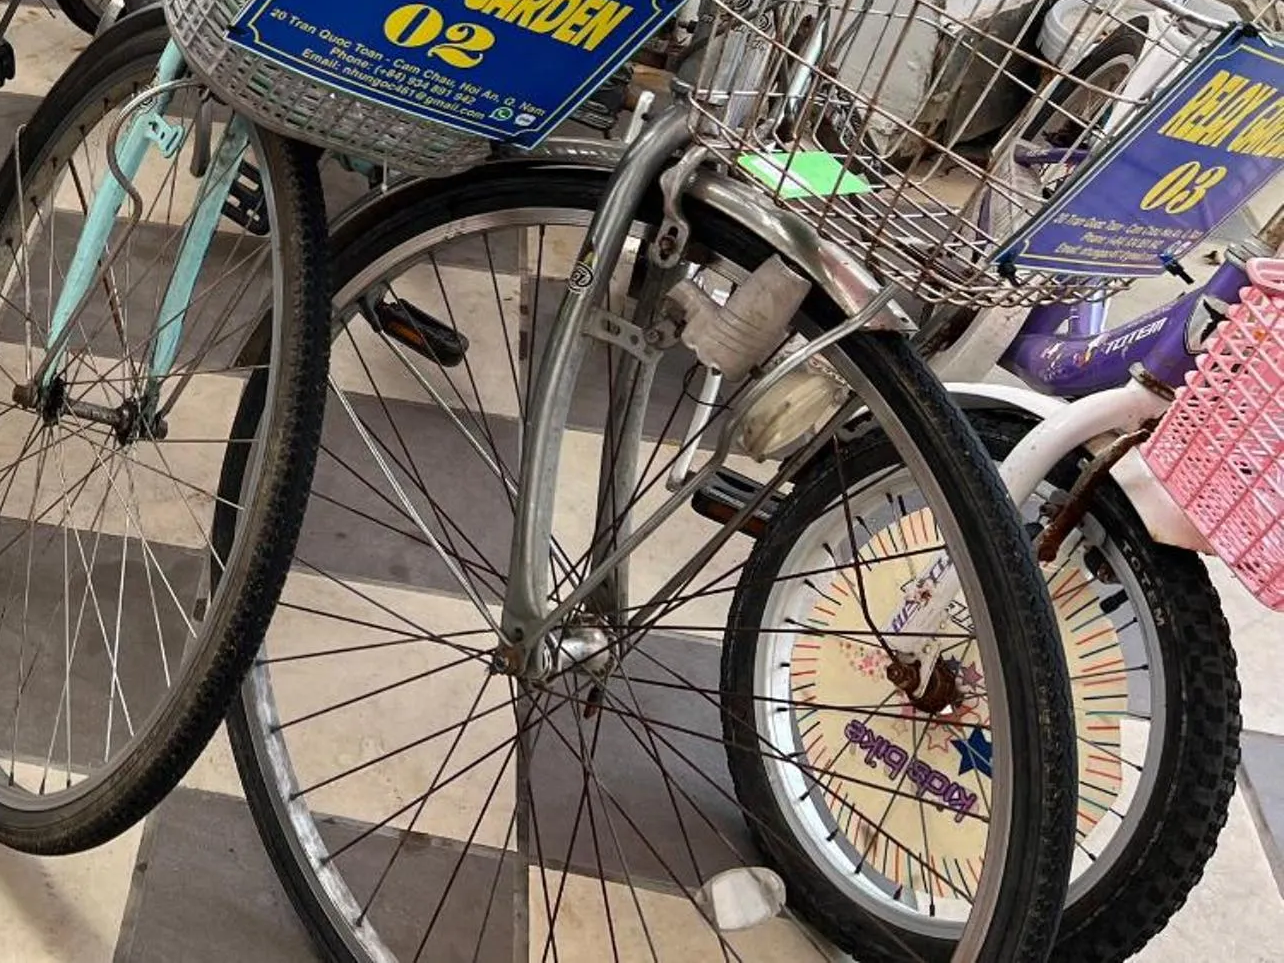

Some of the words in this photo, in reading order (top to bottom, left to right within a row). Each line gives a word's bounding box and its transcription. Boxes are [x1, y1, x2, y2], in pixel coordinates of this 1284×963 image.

[270, 7, 287, 21] 20
[288, 15, 317, 35] Tran
[318, 29, 352, 48] Quoc
[355, 42, 384, 60] Toan
[459, 81, 482, 95] Hoi
[518, 101, 546, 118] Nam
[301, 47, 341, 70] Email:
[329, 46, 374, 71] Phone:
[383, 3, 497, 69] 02
[1157, 69, 1278, 147] RELAX
[1140, 161, 1227, 214] 03
